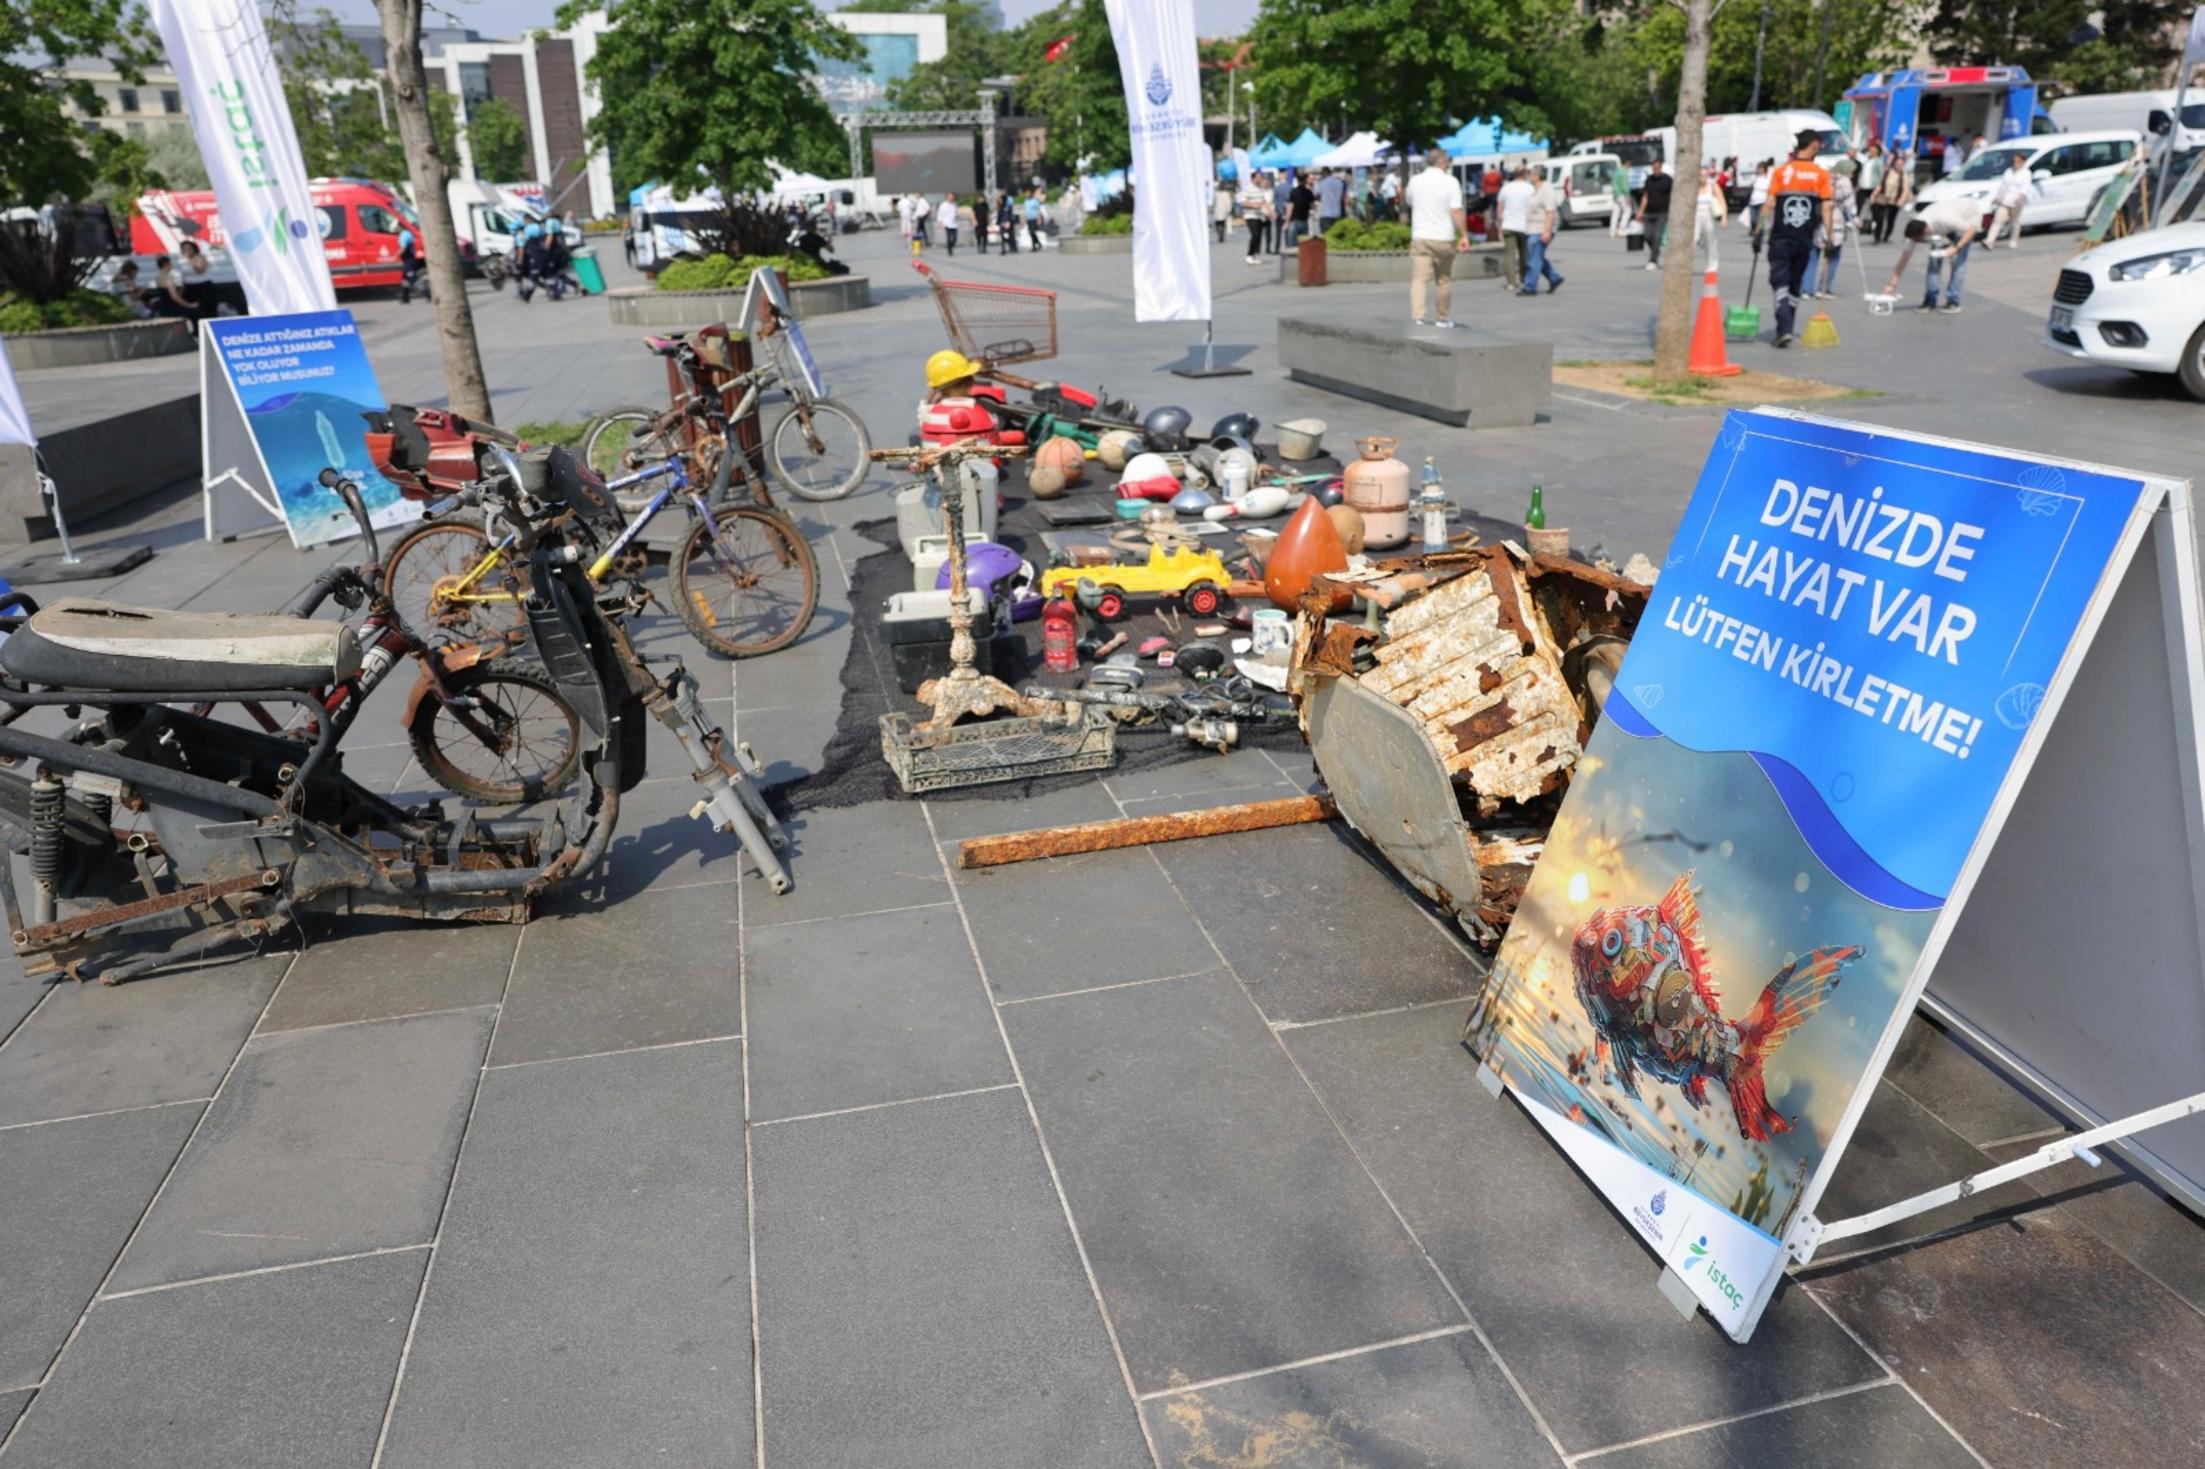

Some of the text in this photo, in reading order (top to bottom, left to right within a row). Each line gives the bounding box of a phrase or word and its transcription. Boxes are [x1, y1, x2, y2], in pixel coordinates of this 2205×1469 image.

[222, 324, 355, 345] DENİZE ATTIĞINIZ ATIKLAR
[227, 340, 335, 360] NE KADAR ZAMANDA
[233, 357, 299, 372] YOK OLUYOR
[238, 366, 335, 386] BİLİYOR MUSUNUZ?
[1760, 479, 1985, 583] DENİZDE
[1716, 534, 1977, 666] HAYAT VAR
[1663, 594, 1984, 760] LÜTFEN KİRLETME!
[1706, 1260, 1744, 1311] istaç
